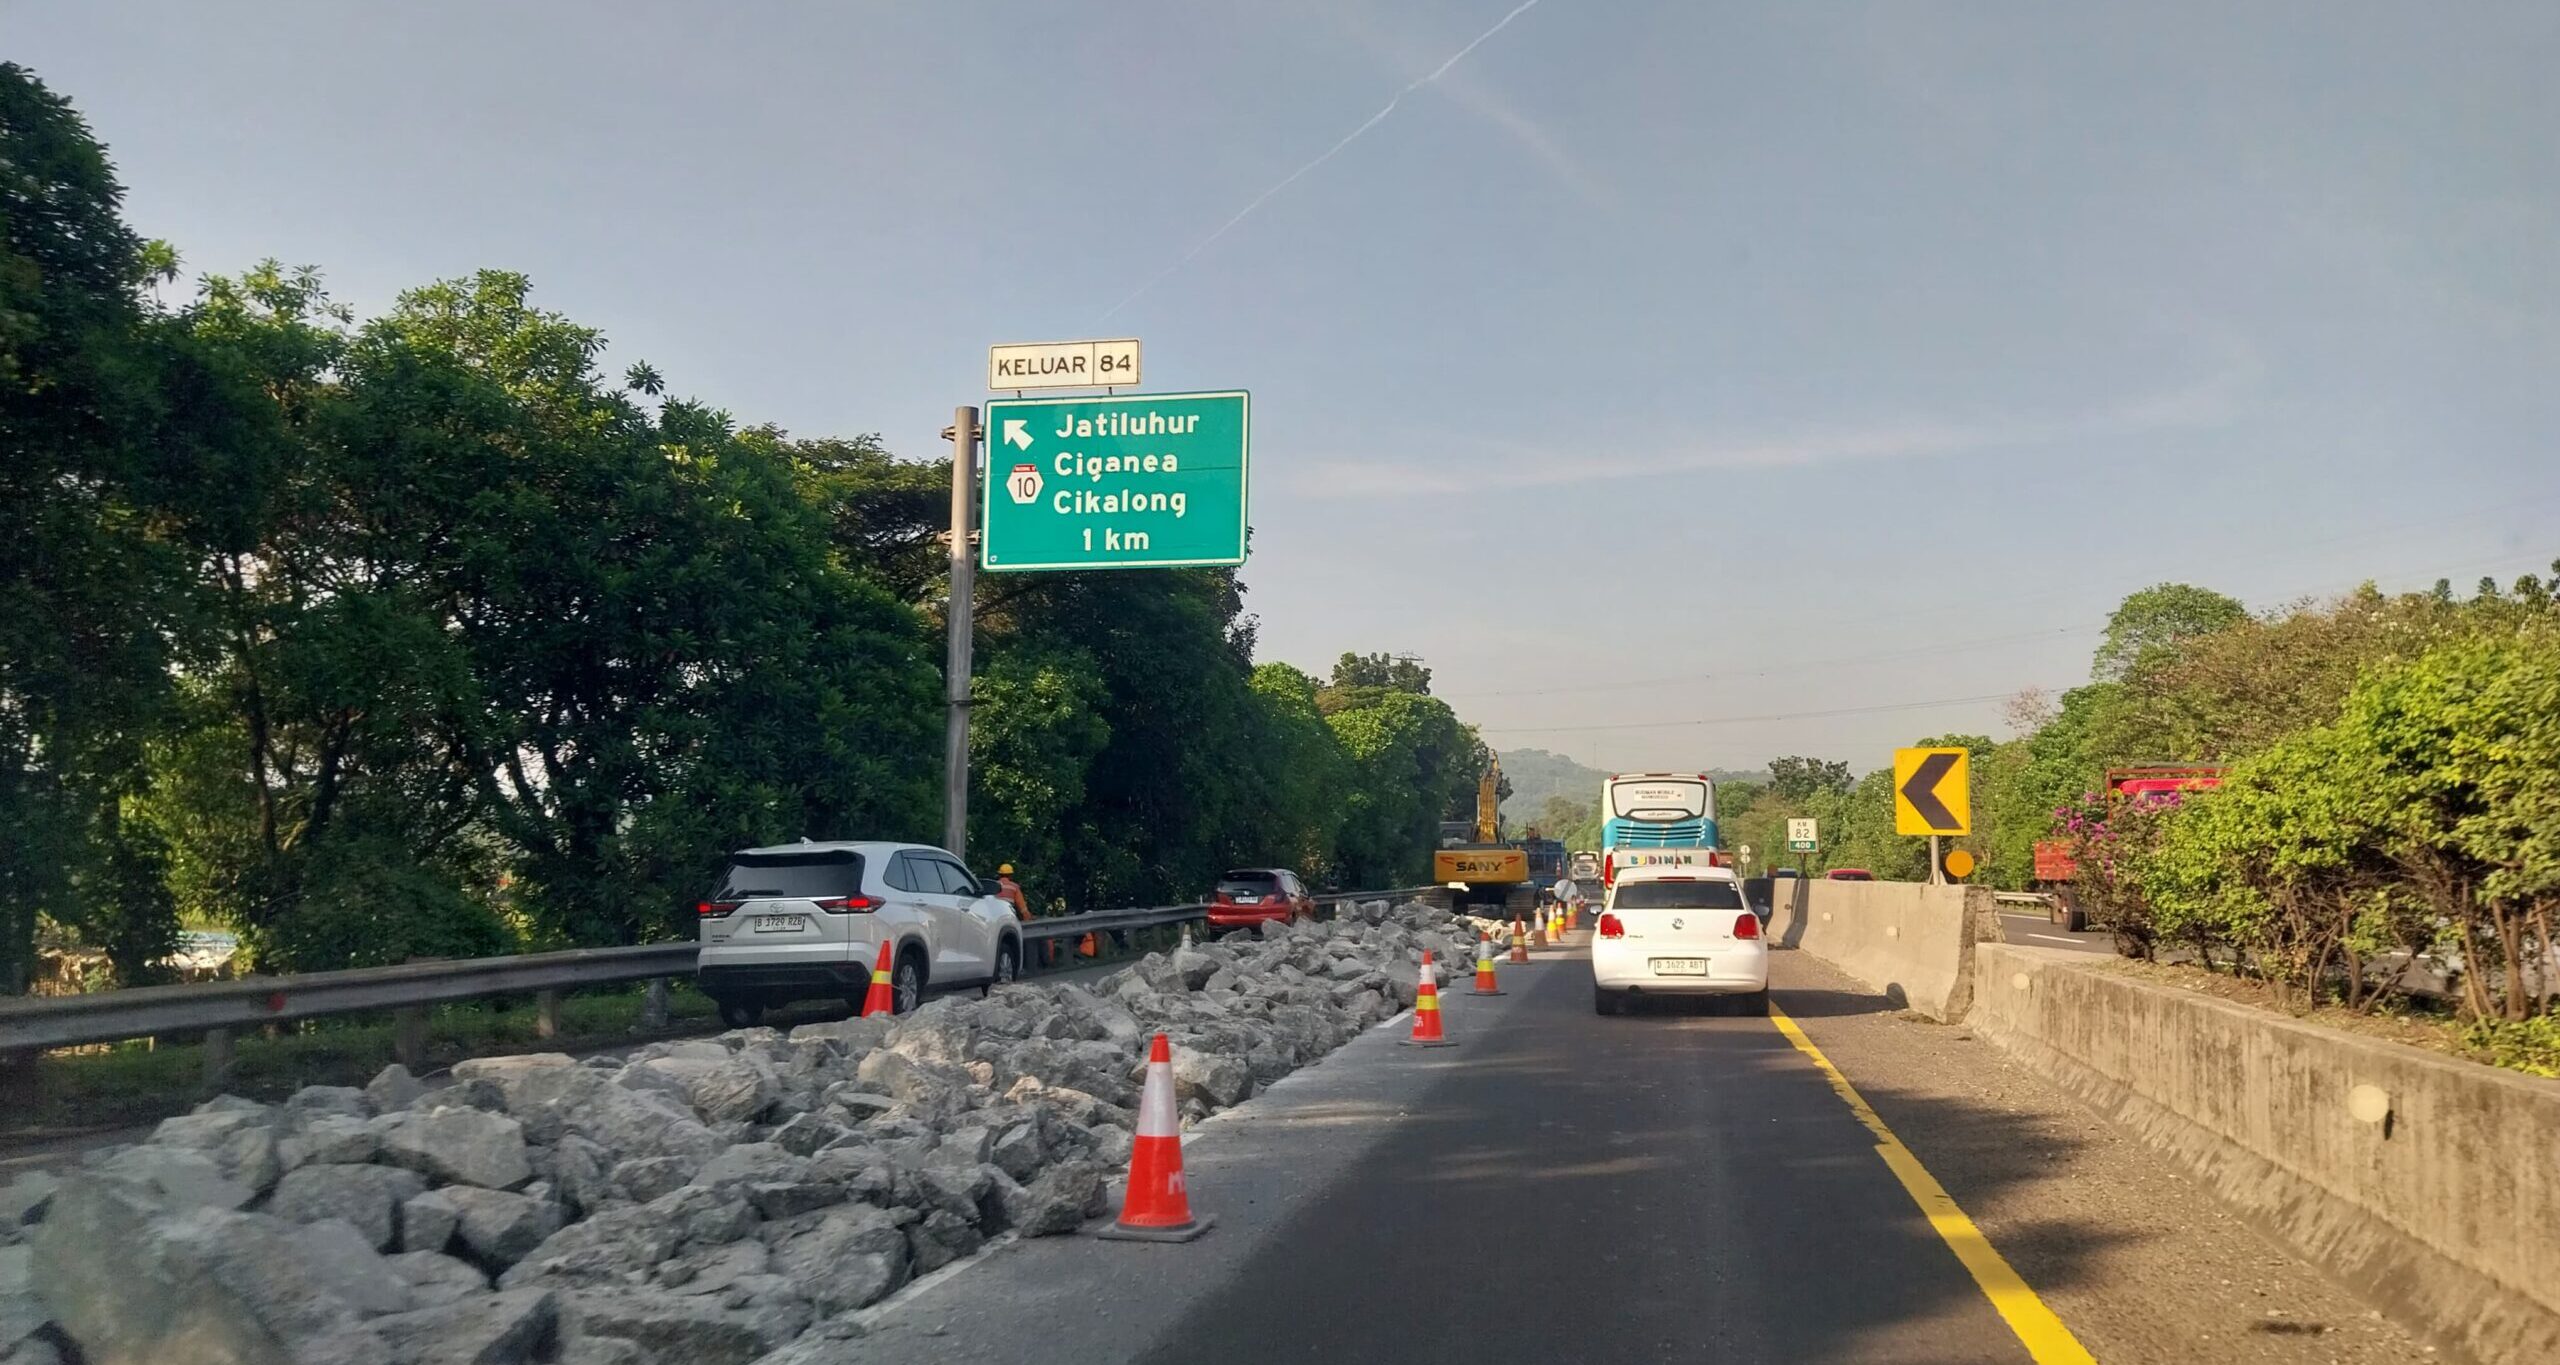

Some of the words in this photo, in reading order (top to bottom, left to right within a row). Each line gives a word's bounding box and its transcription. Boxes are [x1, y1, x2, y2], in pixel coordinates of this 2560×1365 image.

[998, 356, 1086, 376] KELUAR
[1099, 354, 1132, 372] 84
[1055, 411, 1200, 438] Jatiluhur
[1054, 451, 1178, 482] Ciganea
[1017, 476, 1036, 498] 10
[1053, 488, 1187, 518] Cikalong
[1082, 527, 1092, 551] 1
[1105, 527, 1150, 551] km
[1795, 828, 1810, 839] 82
[1795, 841, 1811, 849] 400
[1455, 861, 1502, 872] SANY
[1630, 855, 1693, 866] BUDIMAN
